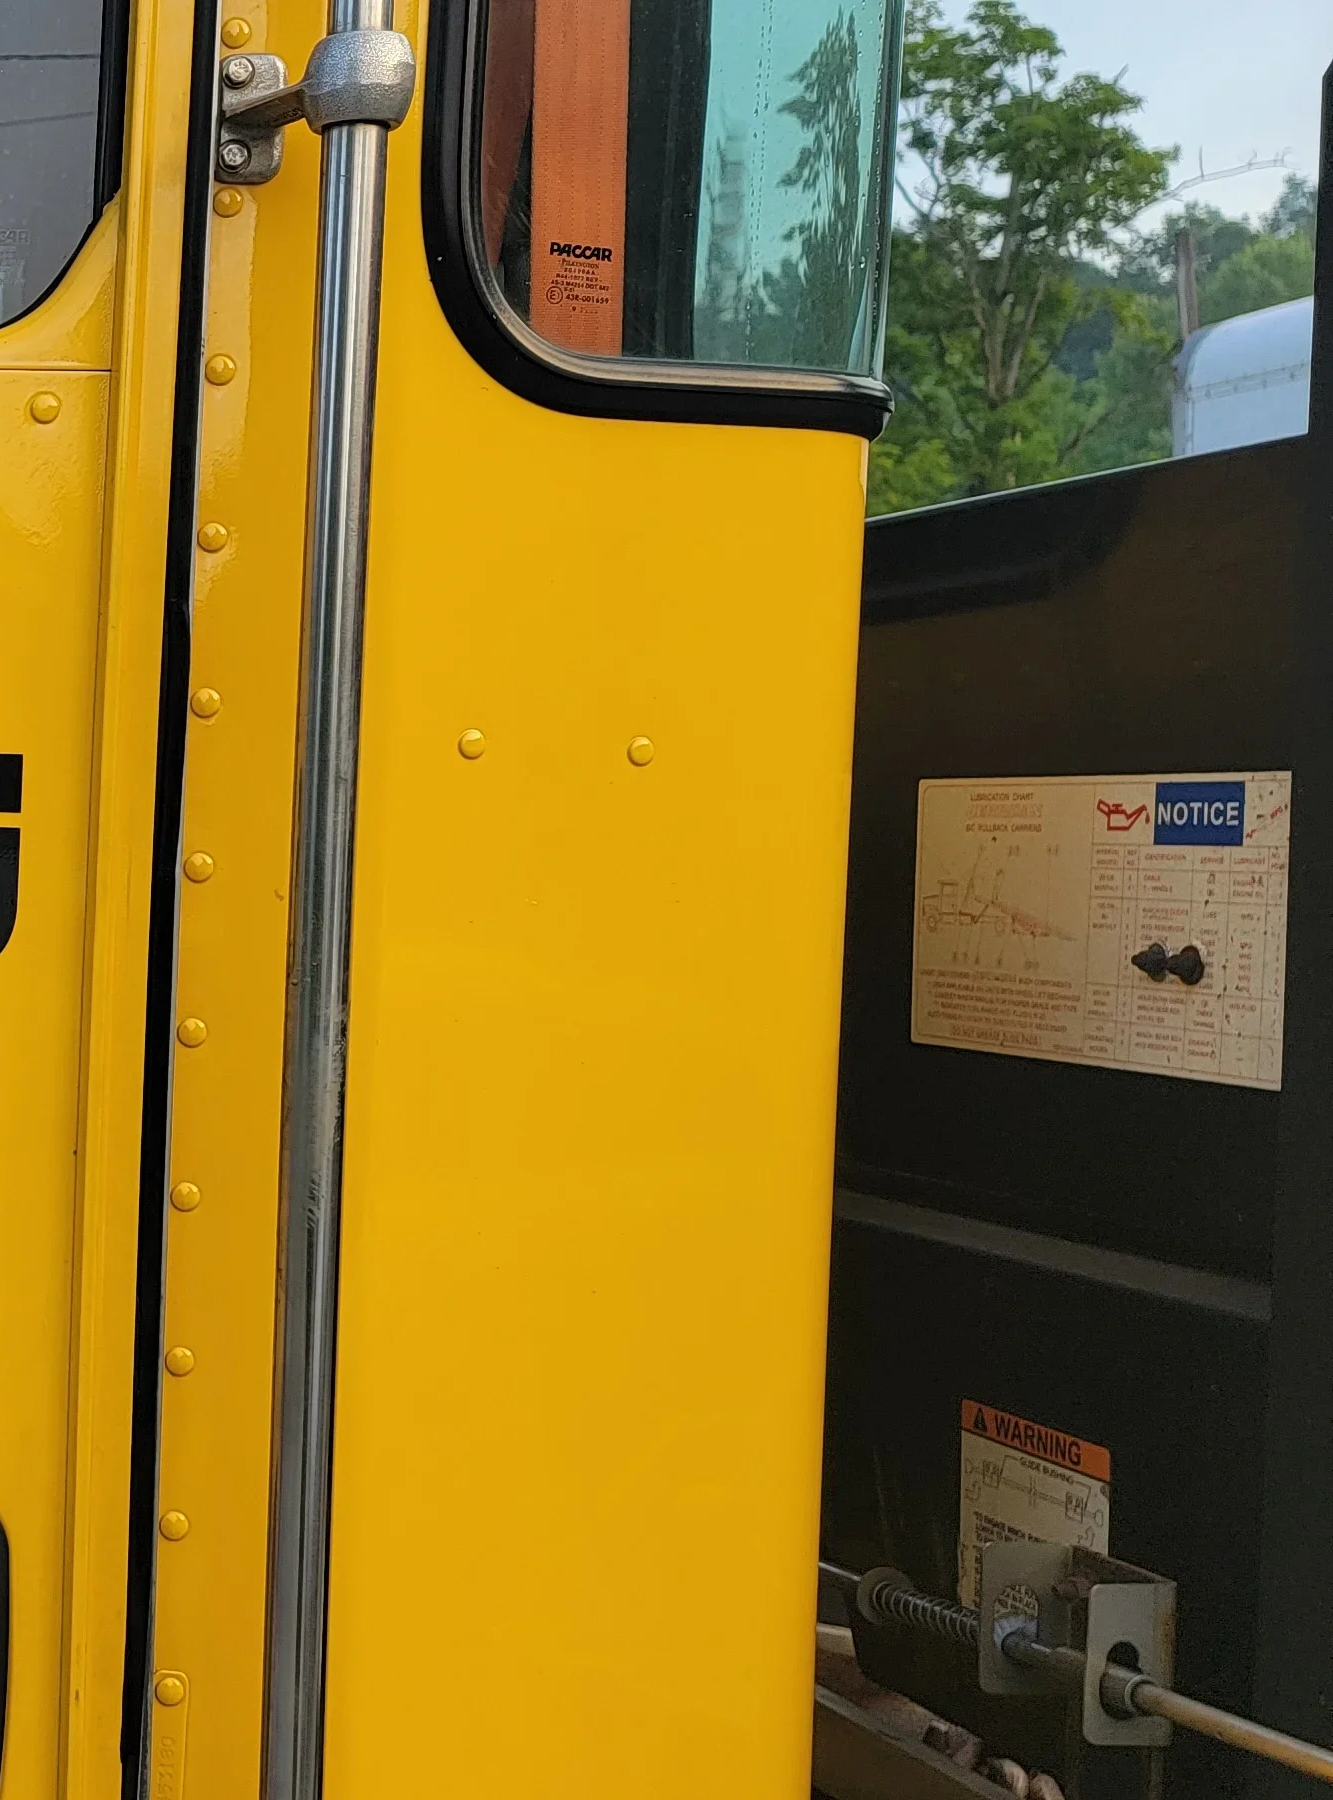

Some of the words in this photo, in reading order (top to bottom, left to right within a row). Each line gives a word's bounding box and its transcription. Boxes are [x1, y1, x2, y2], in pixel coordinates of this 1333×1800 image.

[549, 241, 613, 262] PACCAR
[1012, 792, 1034, 801] CHART
[1158, 800, 1240, 828] NOTICE
[994, 1413, 1083, 1468] WARNING
